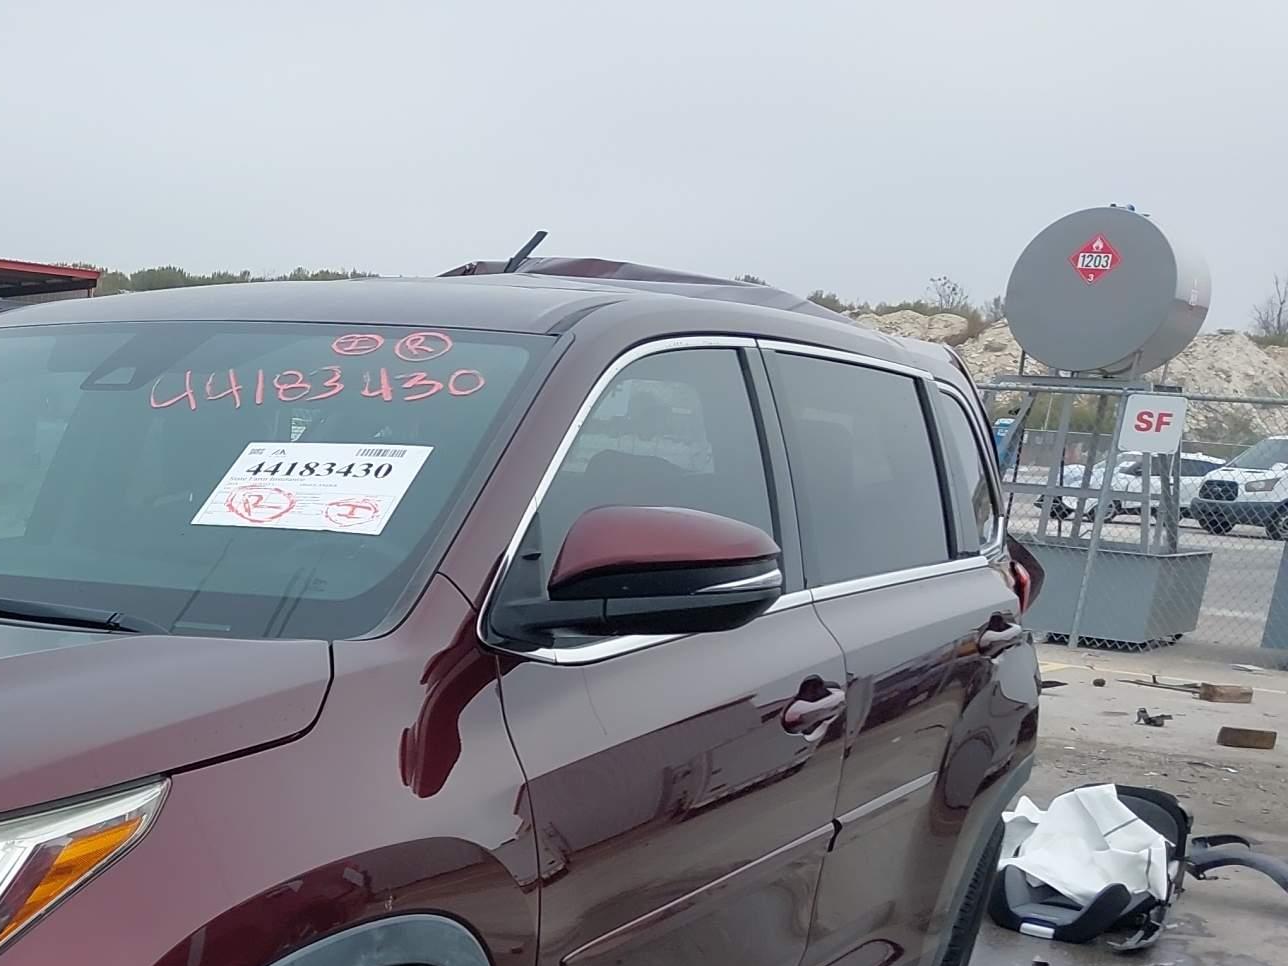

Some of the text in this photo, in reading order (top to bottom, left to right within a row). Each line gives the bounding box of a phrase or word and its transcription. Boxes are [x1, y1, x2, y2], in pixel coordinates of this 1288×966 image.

[1080, 254, 1110, 268] 1203
[1087, 273, 1094, 281] 3
[1134, 410, 1174, 433] SF
[245, 461, 393, 478] 44183430
